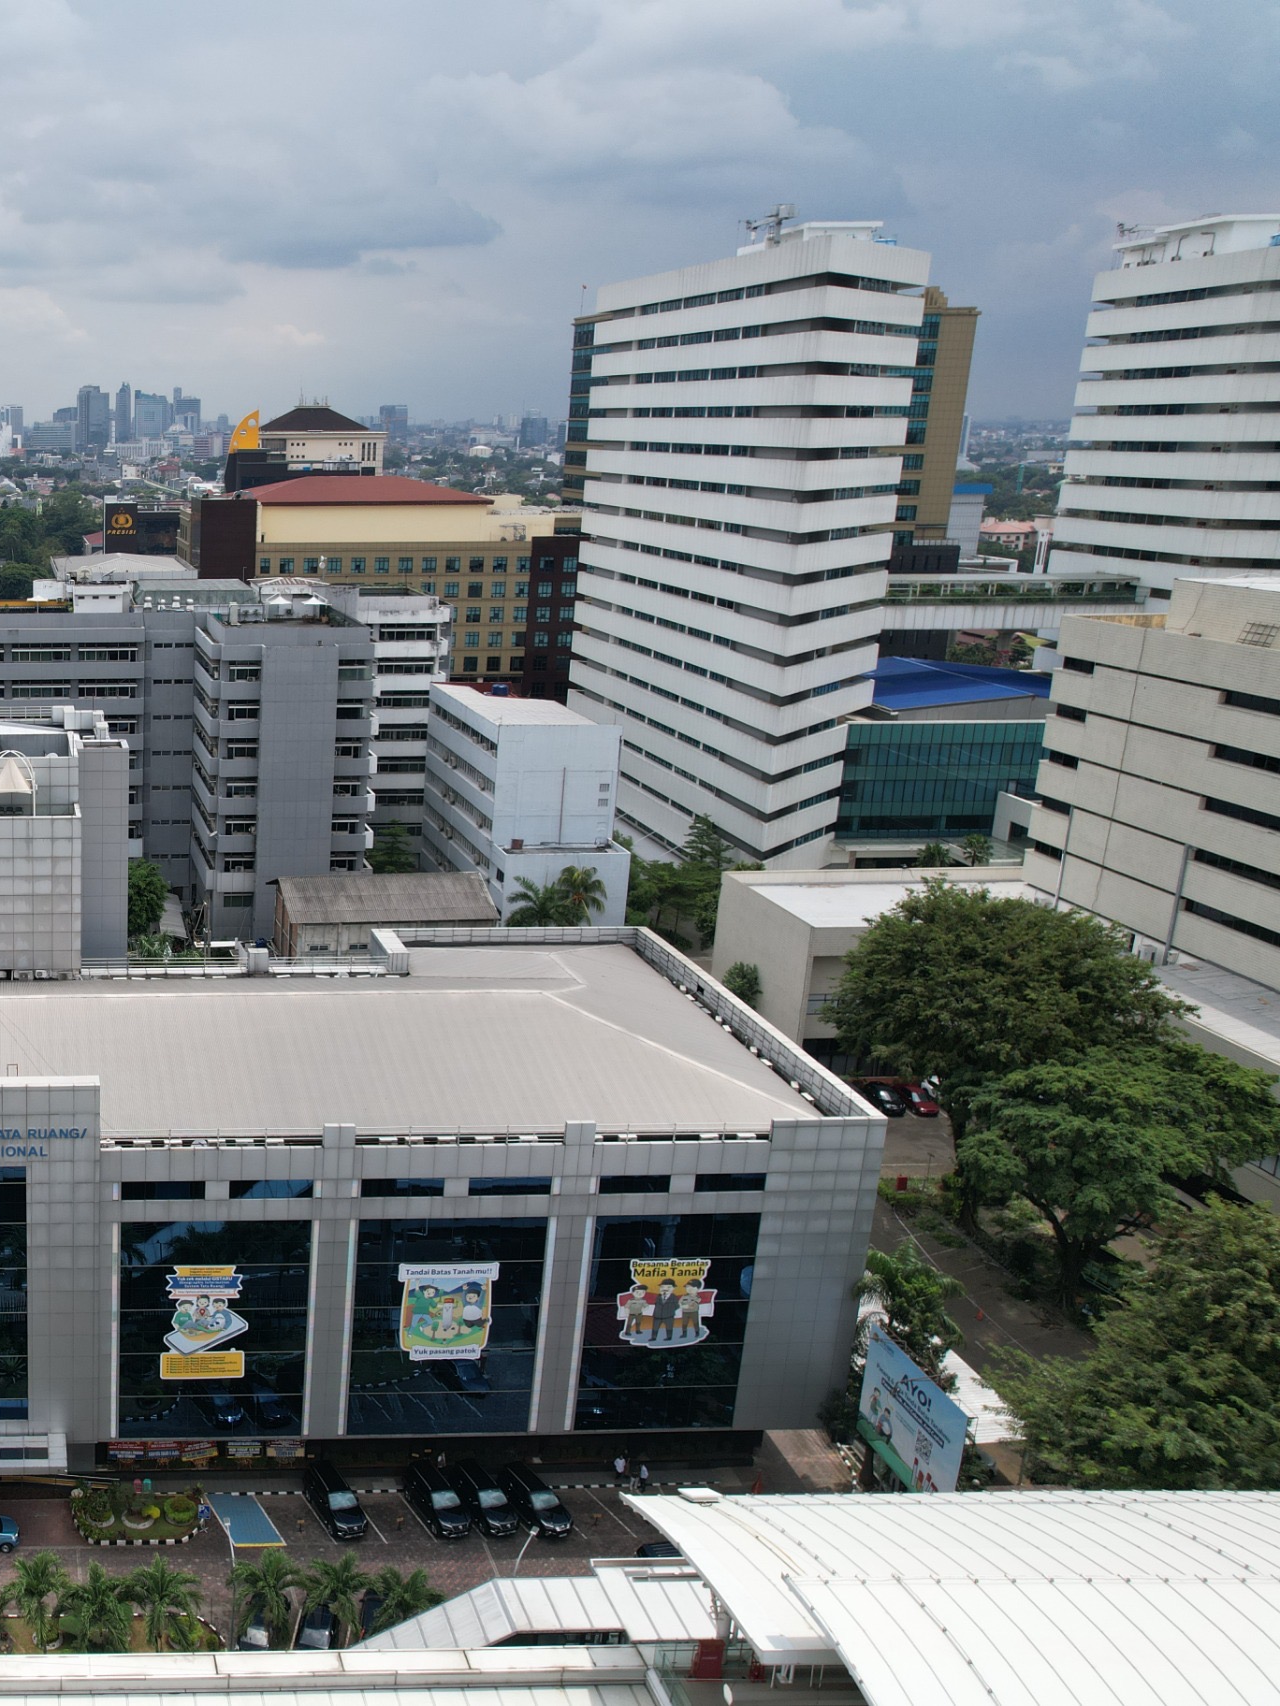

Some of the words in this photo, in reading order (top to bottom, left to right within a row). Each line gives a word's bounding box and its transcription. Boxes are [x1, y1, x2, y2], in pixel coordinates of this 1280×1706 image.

[28, 1128, 88, 1140] RUANG/
[633, 1268, 667, 1277] Mafia
[670, 1267, 705, 1276] Tanah
[900, 1374, 932, 1412] AYO!
